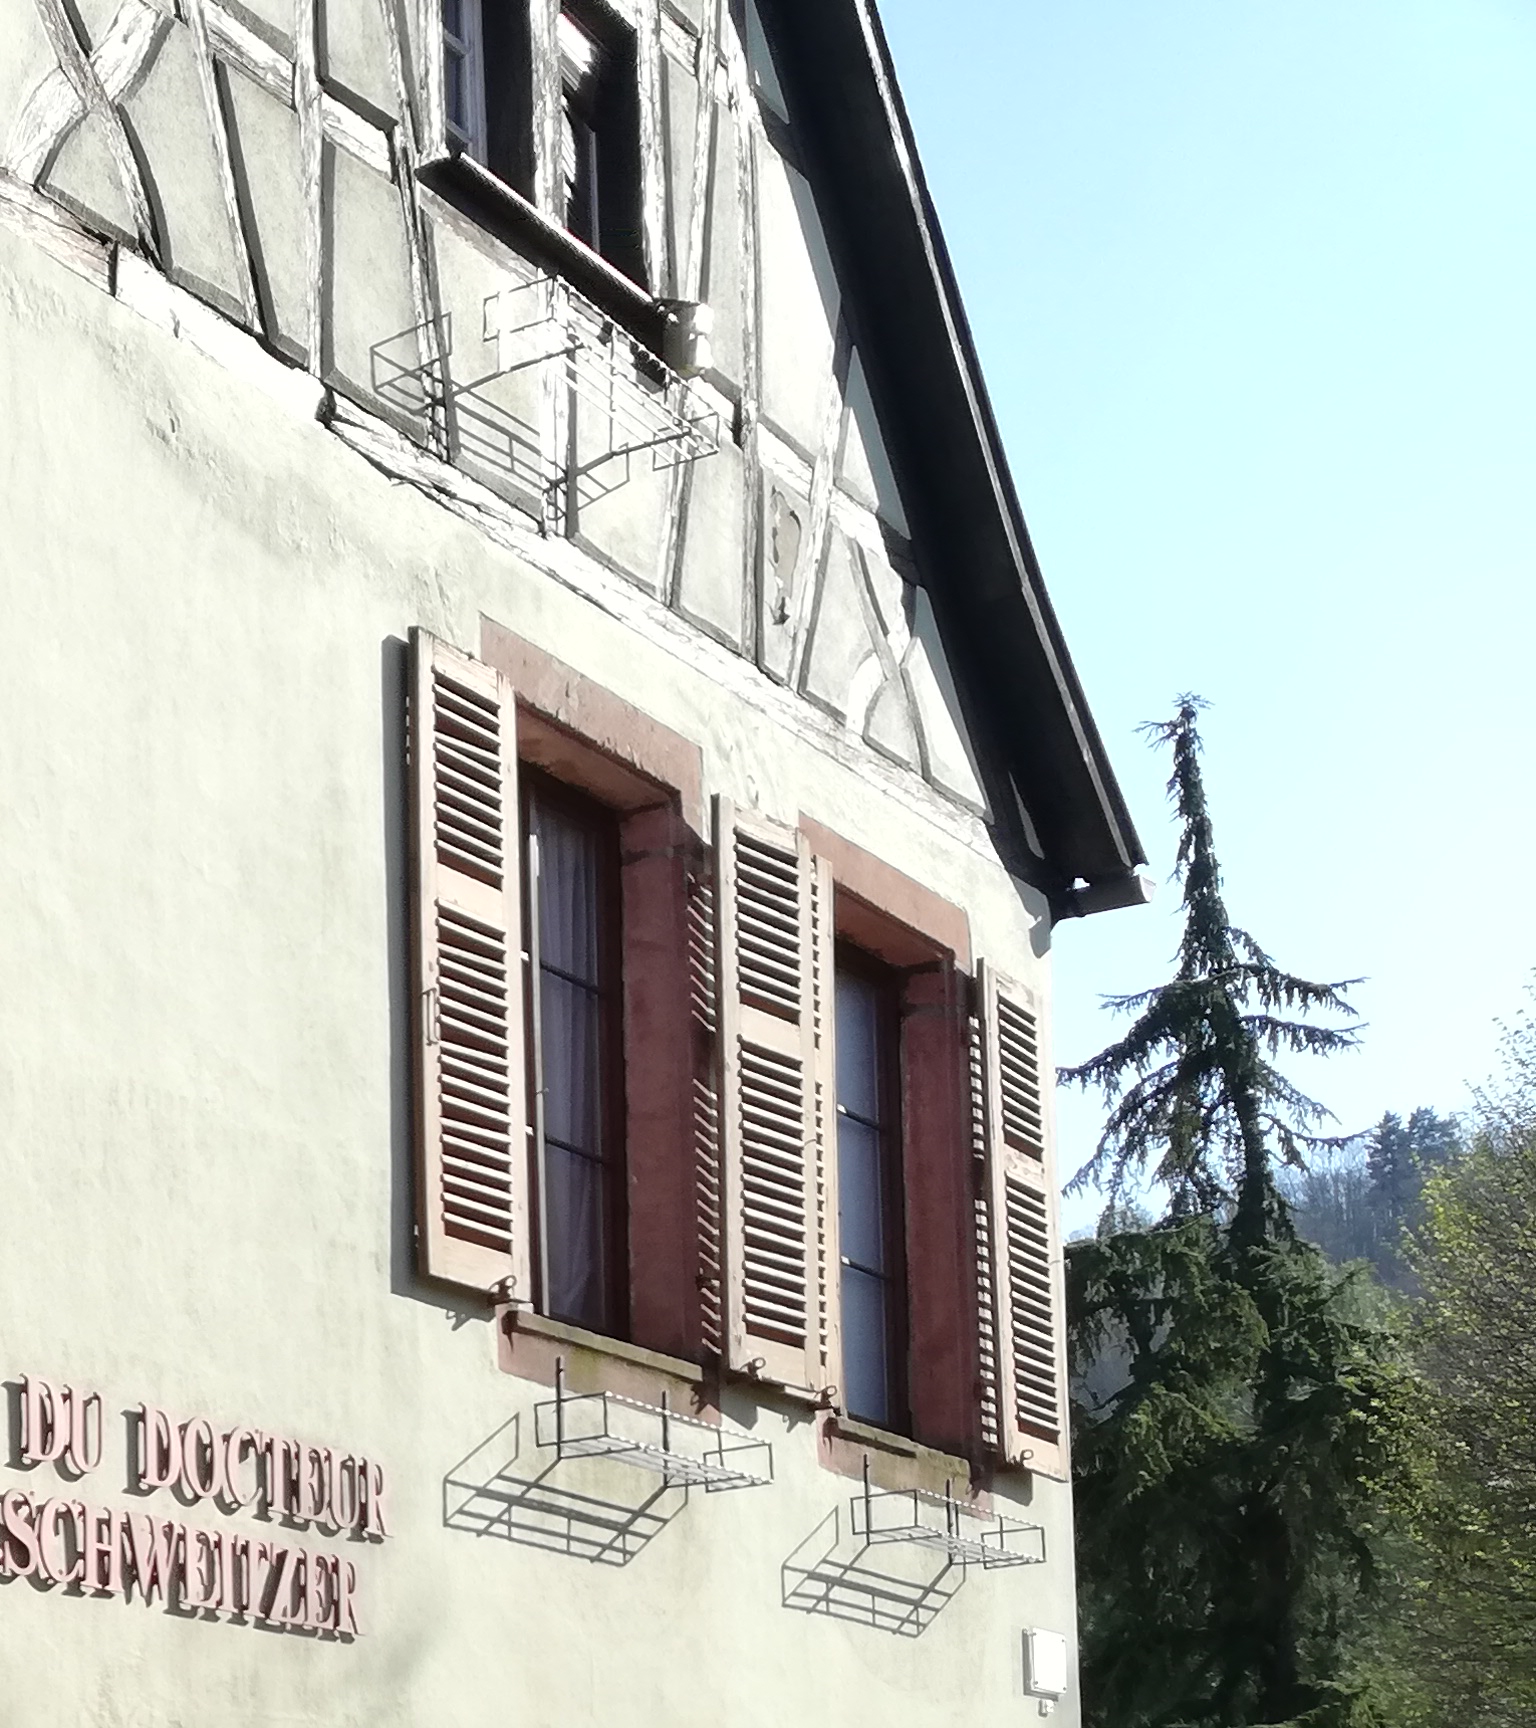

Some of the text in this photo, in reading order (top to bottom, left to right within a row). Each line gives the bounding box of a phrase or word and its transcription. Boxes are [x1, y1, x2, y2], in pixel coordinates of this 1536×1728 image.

[18, 1373, 104, 1474] DU
[138, 1402, 394, 1538] DOCTEUR
[1, 1487, 366, 1637] SCHWEITZER
